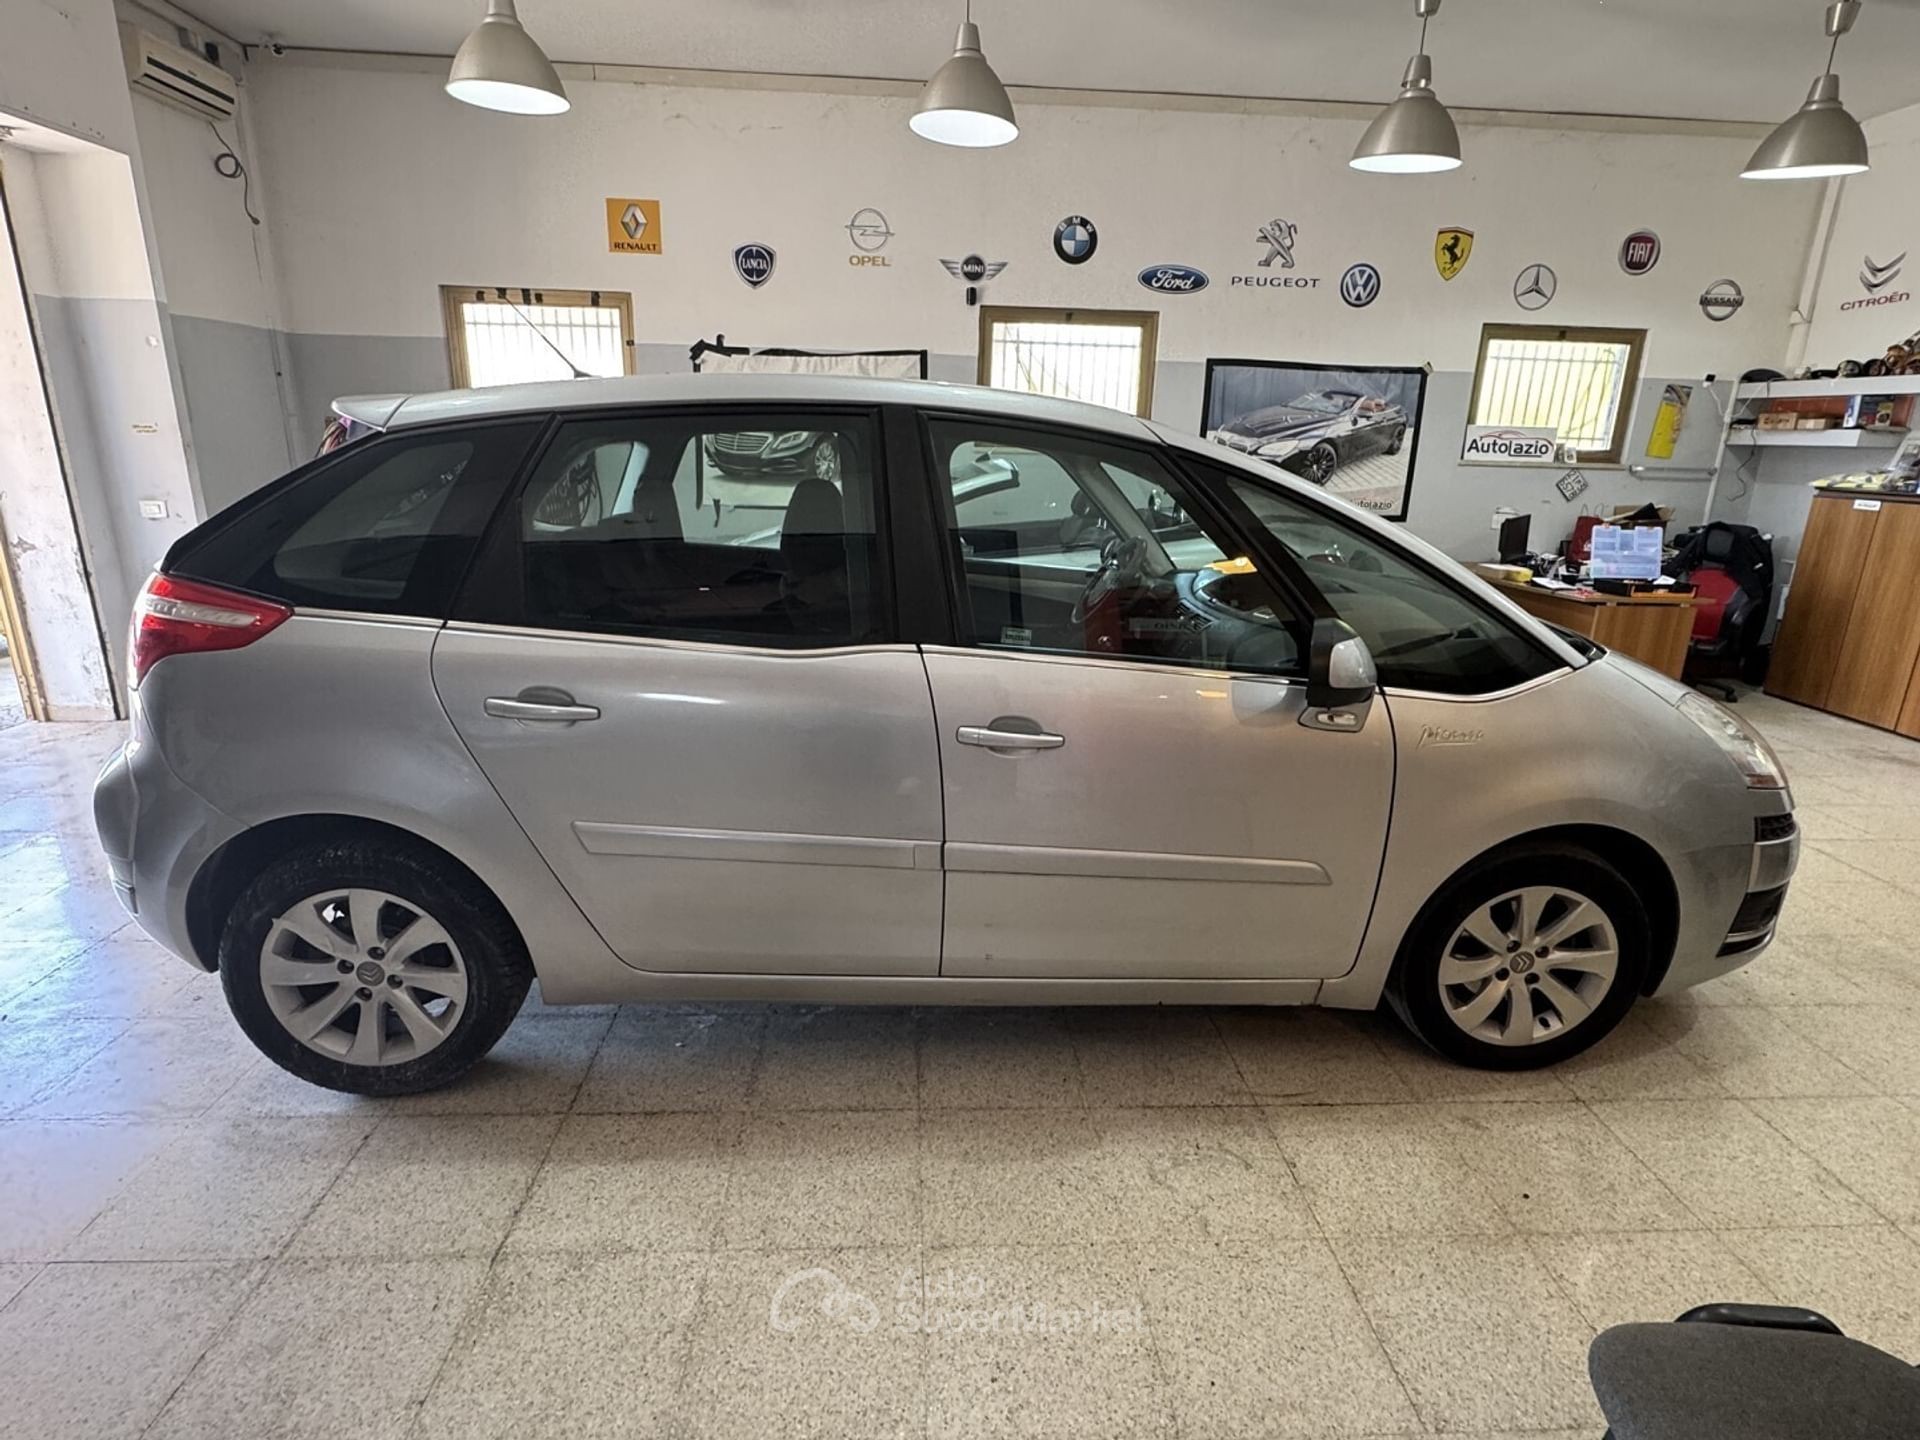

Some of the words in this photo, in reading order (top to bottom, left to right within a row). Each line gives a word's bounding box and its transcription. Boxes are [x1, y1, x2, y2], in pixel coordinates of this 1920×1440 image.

[613, 241, 657, 252] RENAULT
[1627, 242, 1653, 263] FIAT
[742, 257, 769, 271] LANCIA
[848, 255, 892, 267] OPEL
[963, 263, 985, 274] MINI
[1151, 268, 1197, 291] Ford
[1231, 275, 1321, 289] PEUGEOT
[1702, 296, 1742, 305] NISSAN
